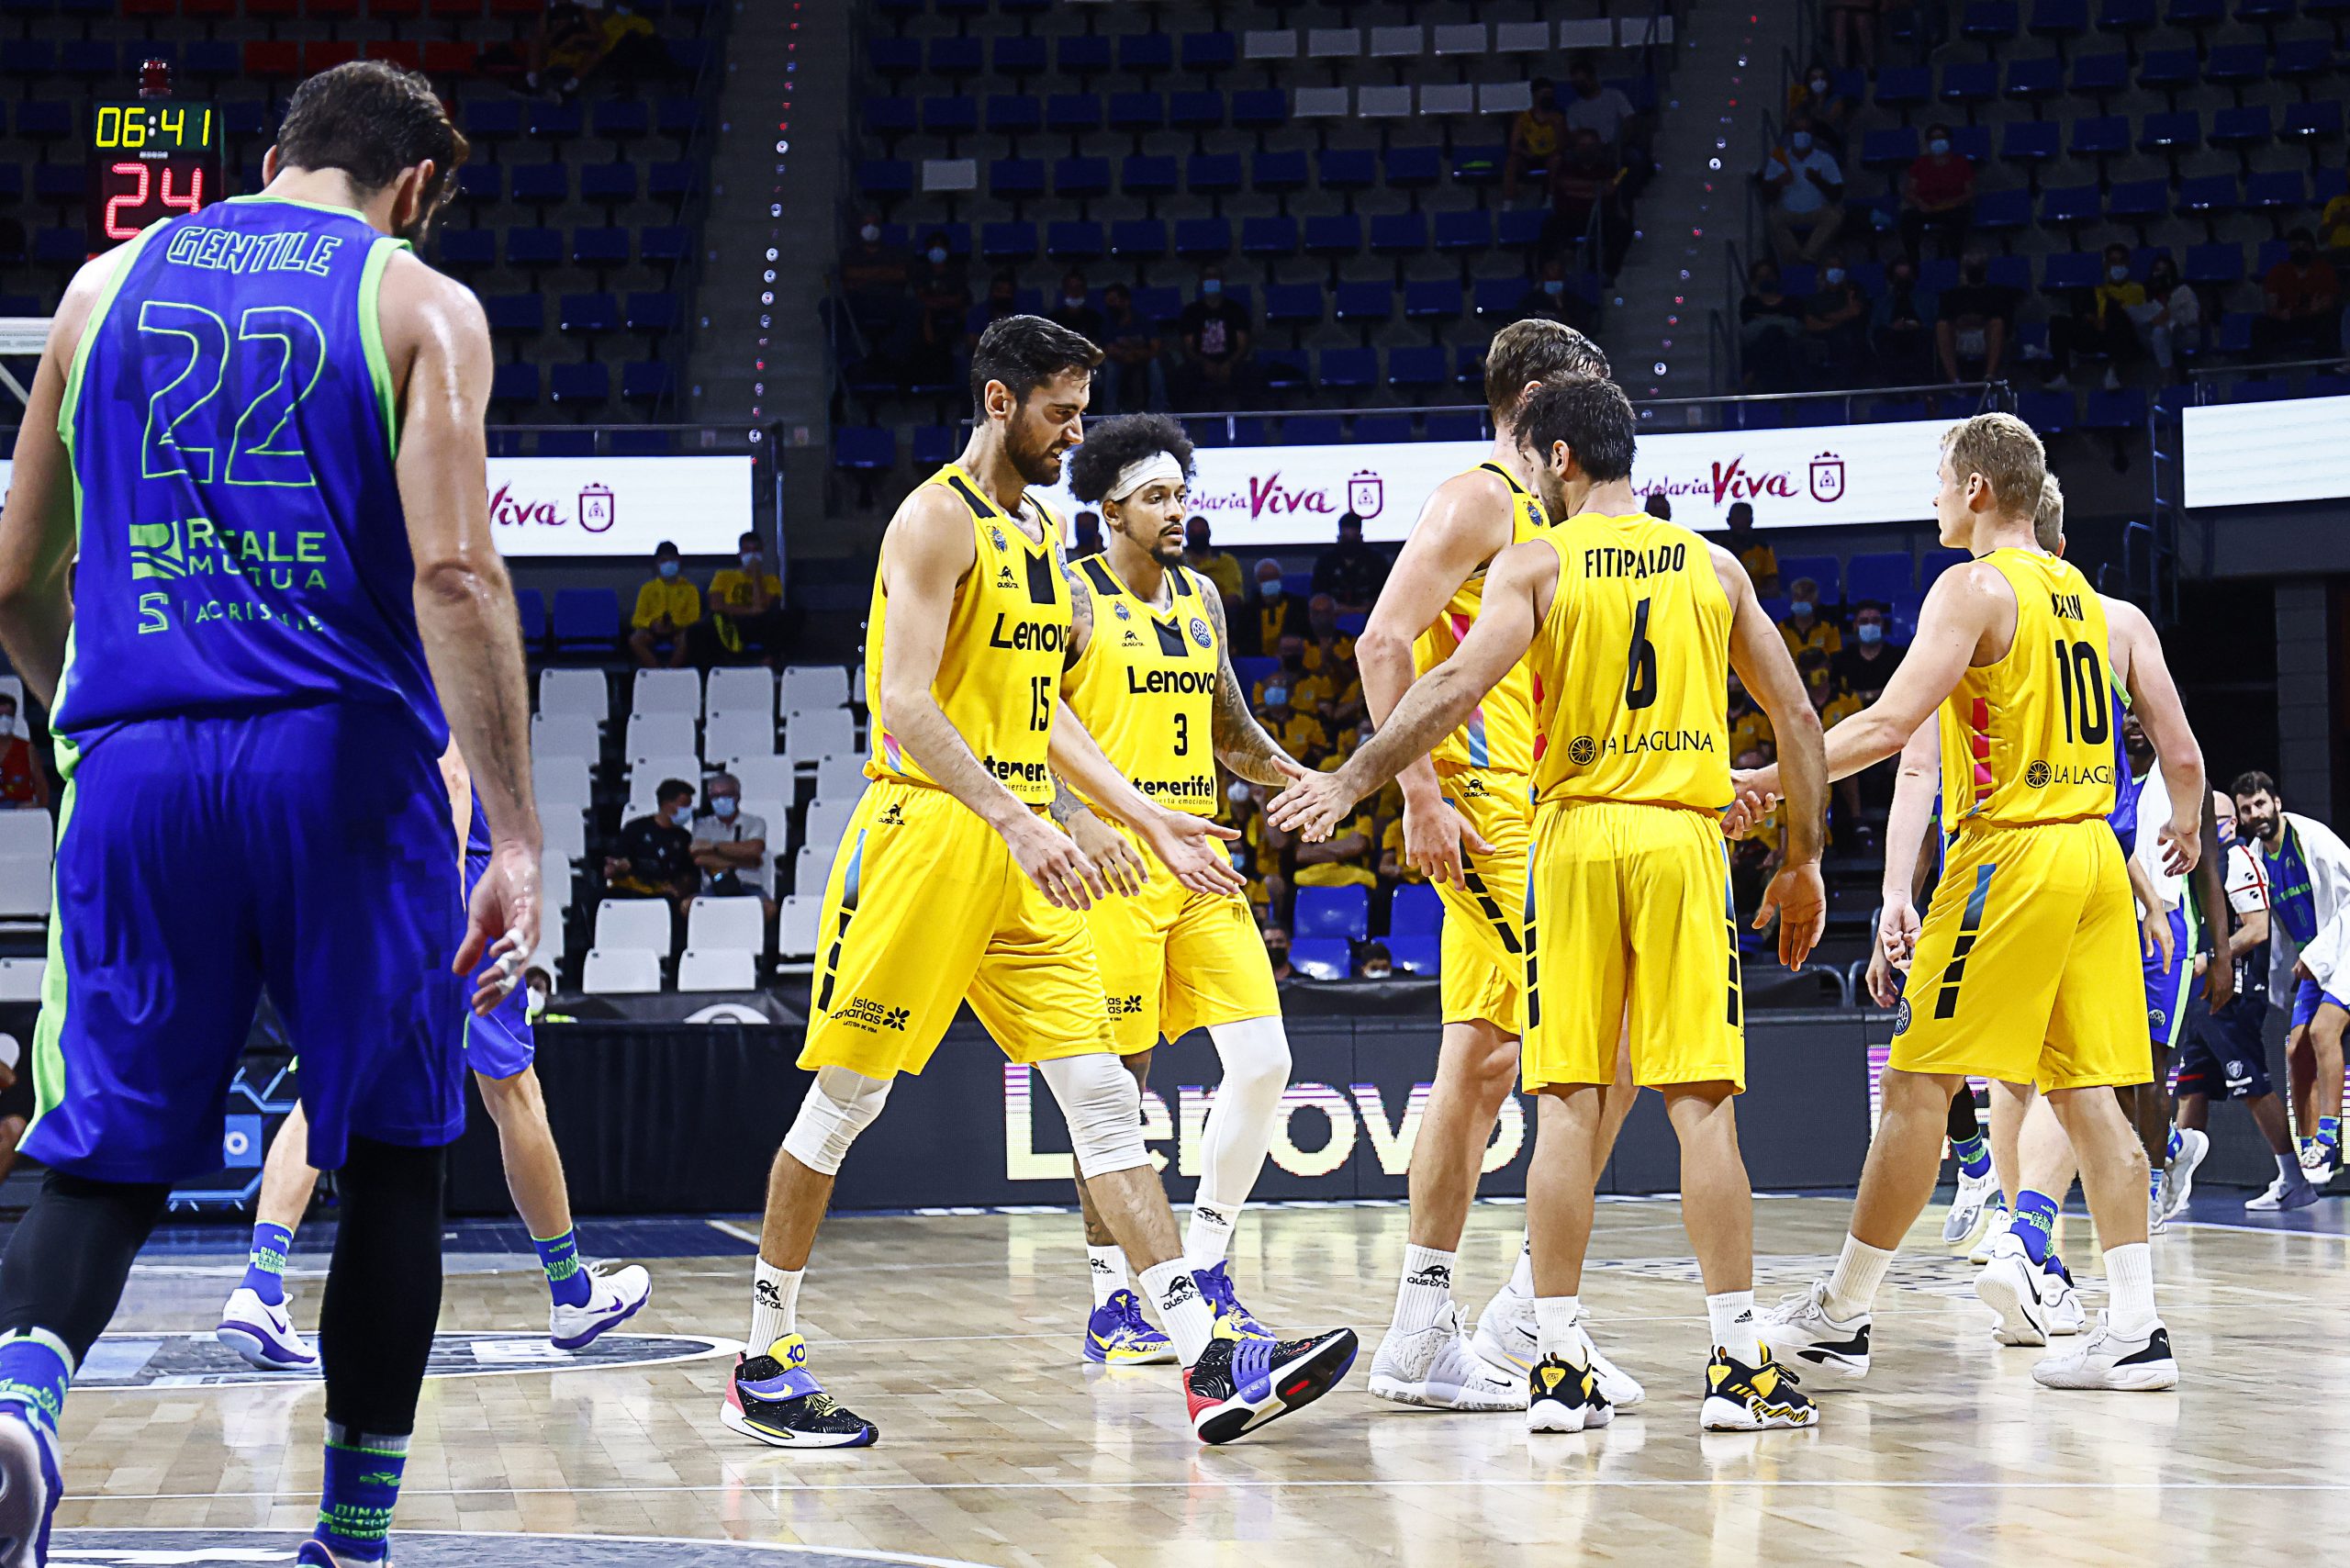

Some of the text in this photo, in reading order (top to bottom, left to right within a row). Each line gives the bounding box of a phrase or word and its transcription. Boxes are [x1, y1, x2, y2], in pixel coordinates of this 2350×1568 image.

[95, 107, 211, 147] 06:41
[105, 162, 203, 240] 24
[166, 226, 342, 276] GENTILE
[138, 300, 326, 487] 22
[1249, 470, 1337, 521] Viva
[1712, 454, 1799, 506] Viva
[188, 554, 327, 589] MUTUA
[1585, 543, 1686, 578] FITIPALDO
[990, 612, 1070, 653] Lenov
[1626, 597, 1657, 711] 6
[1126, 666, 1215, 695] Lenovo
[2055, 639, 2109, 745] 10
[1030, 677, 1051, 731] 15
[1173, 713, 1188, 756] 3
[1623, 731, 1714, 754] LAGUNA
[2054, 765, 2069, 784] LA
[852, 996, 885, 1014] Islas
